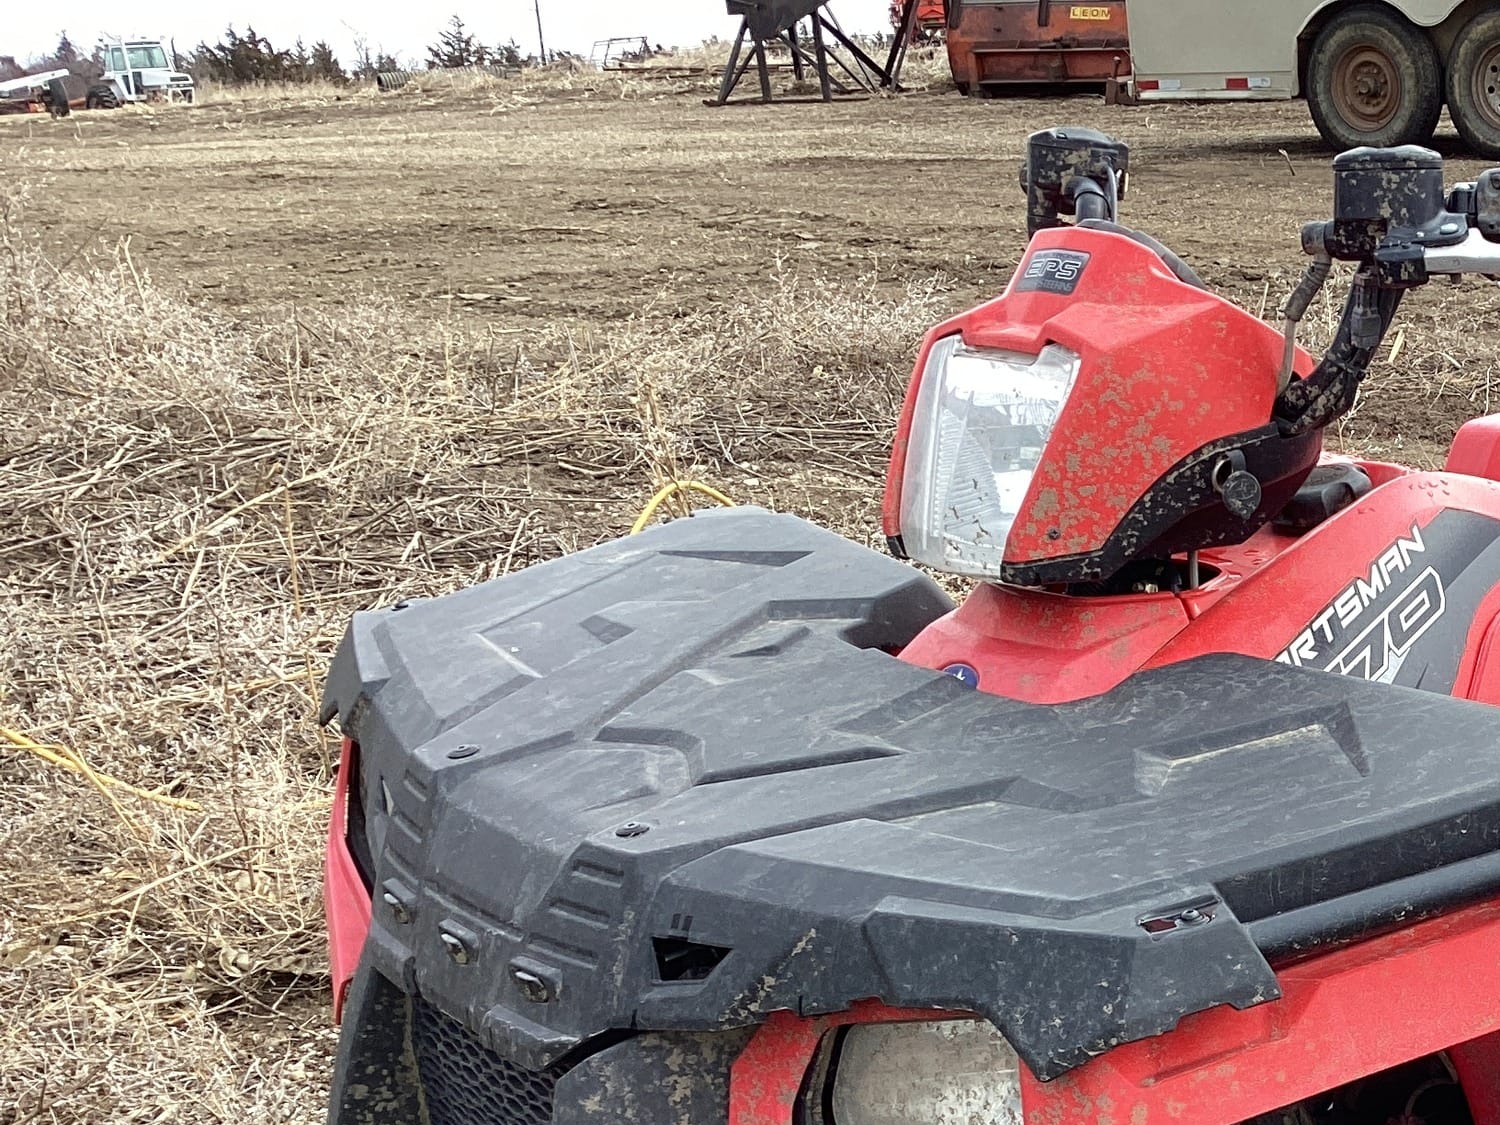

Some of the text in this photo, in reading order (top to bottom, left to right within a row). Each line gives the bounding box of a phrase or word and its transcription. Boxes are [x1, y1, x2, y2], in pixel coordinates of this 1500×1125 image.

[1072, 8, 1110, 18] LEON
[1025, 258, 1082, 280] EPS
[1275, 524, 1426, 668] RTSMAN
[1323, 565, 1446, 682] 70
